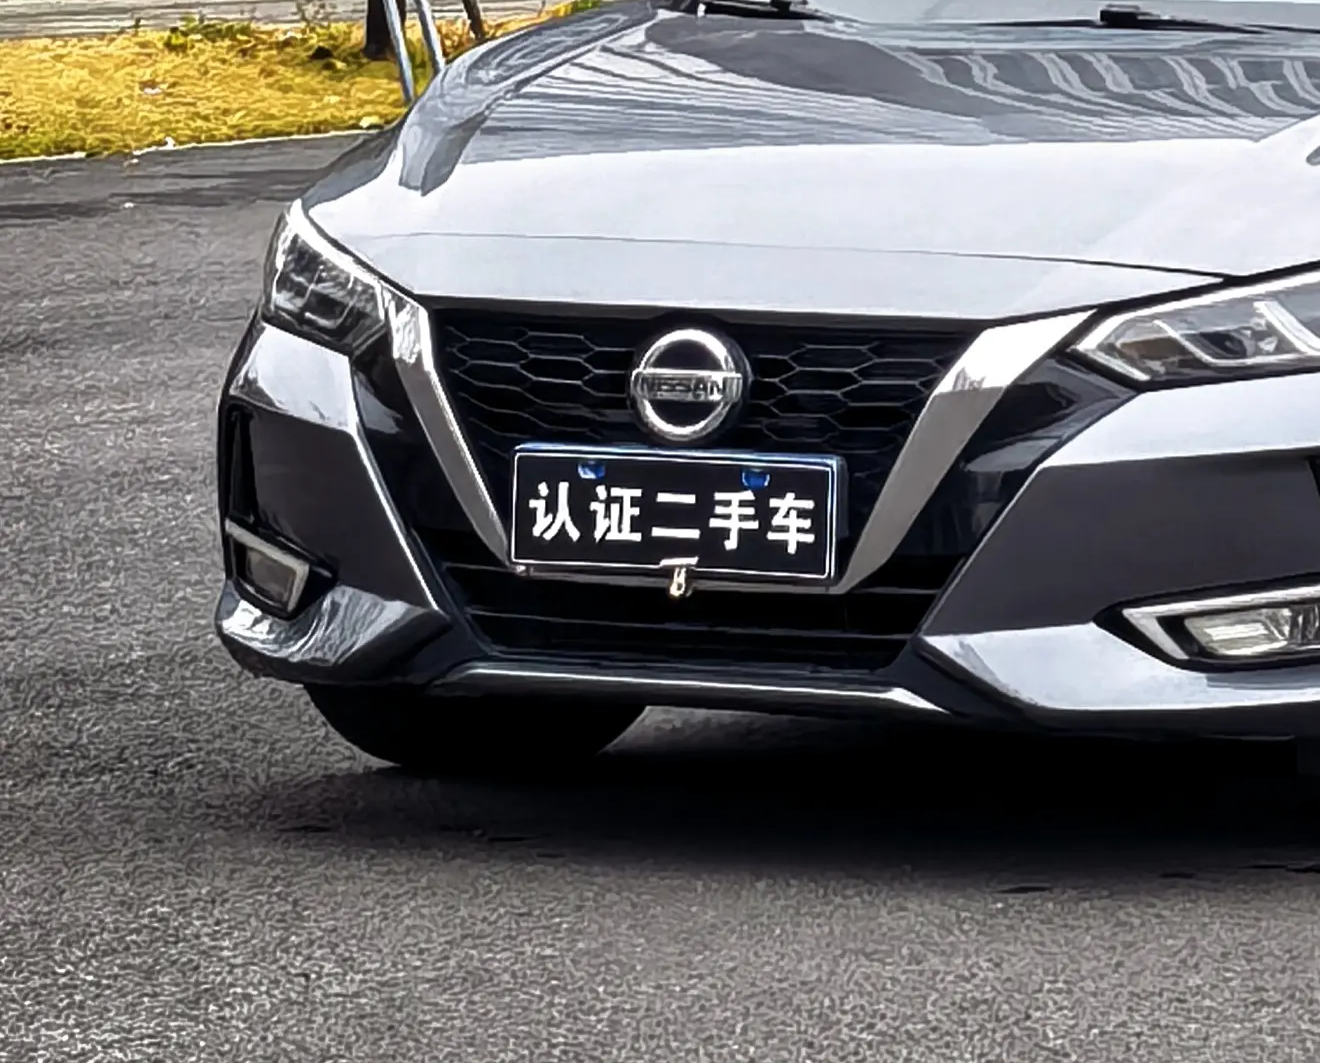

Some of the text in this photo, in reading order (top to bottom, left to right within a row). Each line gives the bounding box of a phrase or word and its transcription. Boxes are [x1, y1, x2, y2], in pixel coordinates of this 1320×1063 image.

[528, 481, 815, 555] 认证二手车
